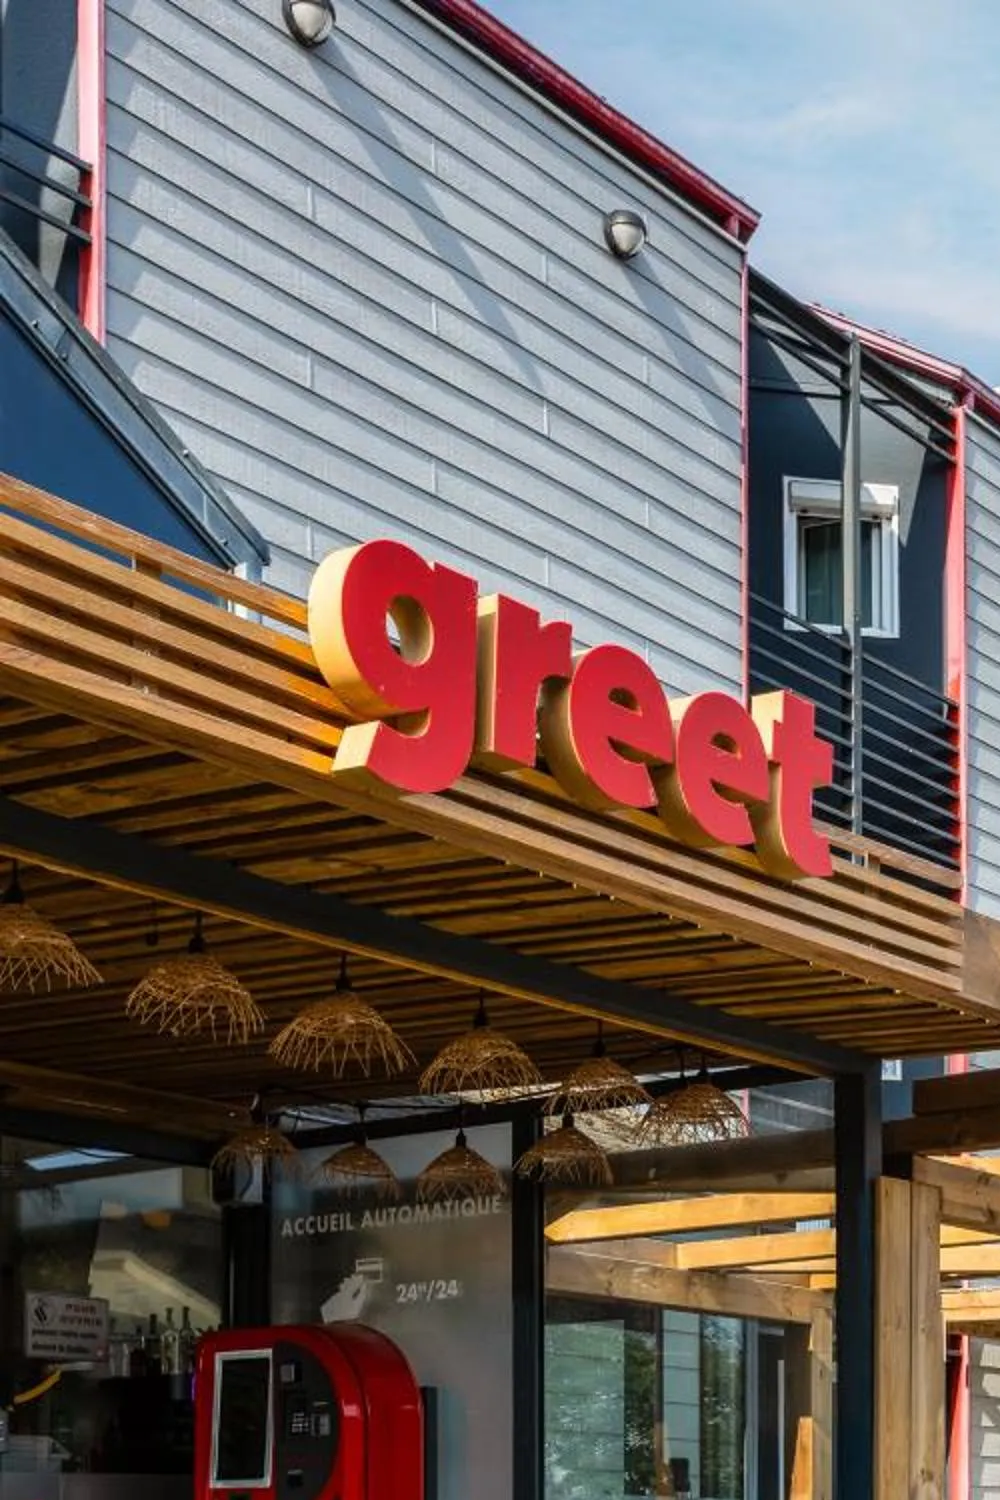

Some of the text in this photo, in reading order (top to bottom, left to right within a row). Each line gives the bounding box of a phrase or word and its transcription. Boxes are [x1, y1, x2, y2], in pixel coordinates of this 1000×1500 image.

[310, 538, 833, 877] greet
[281, 1195, 502, 1240] ACCUEIL AUTOMATIQUE
